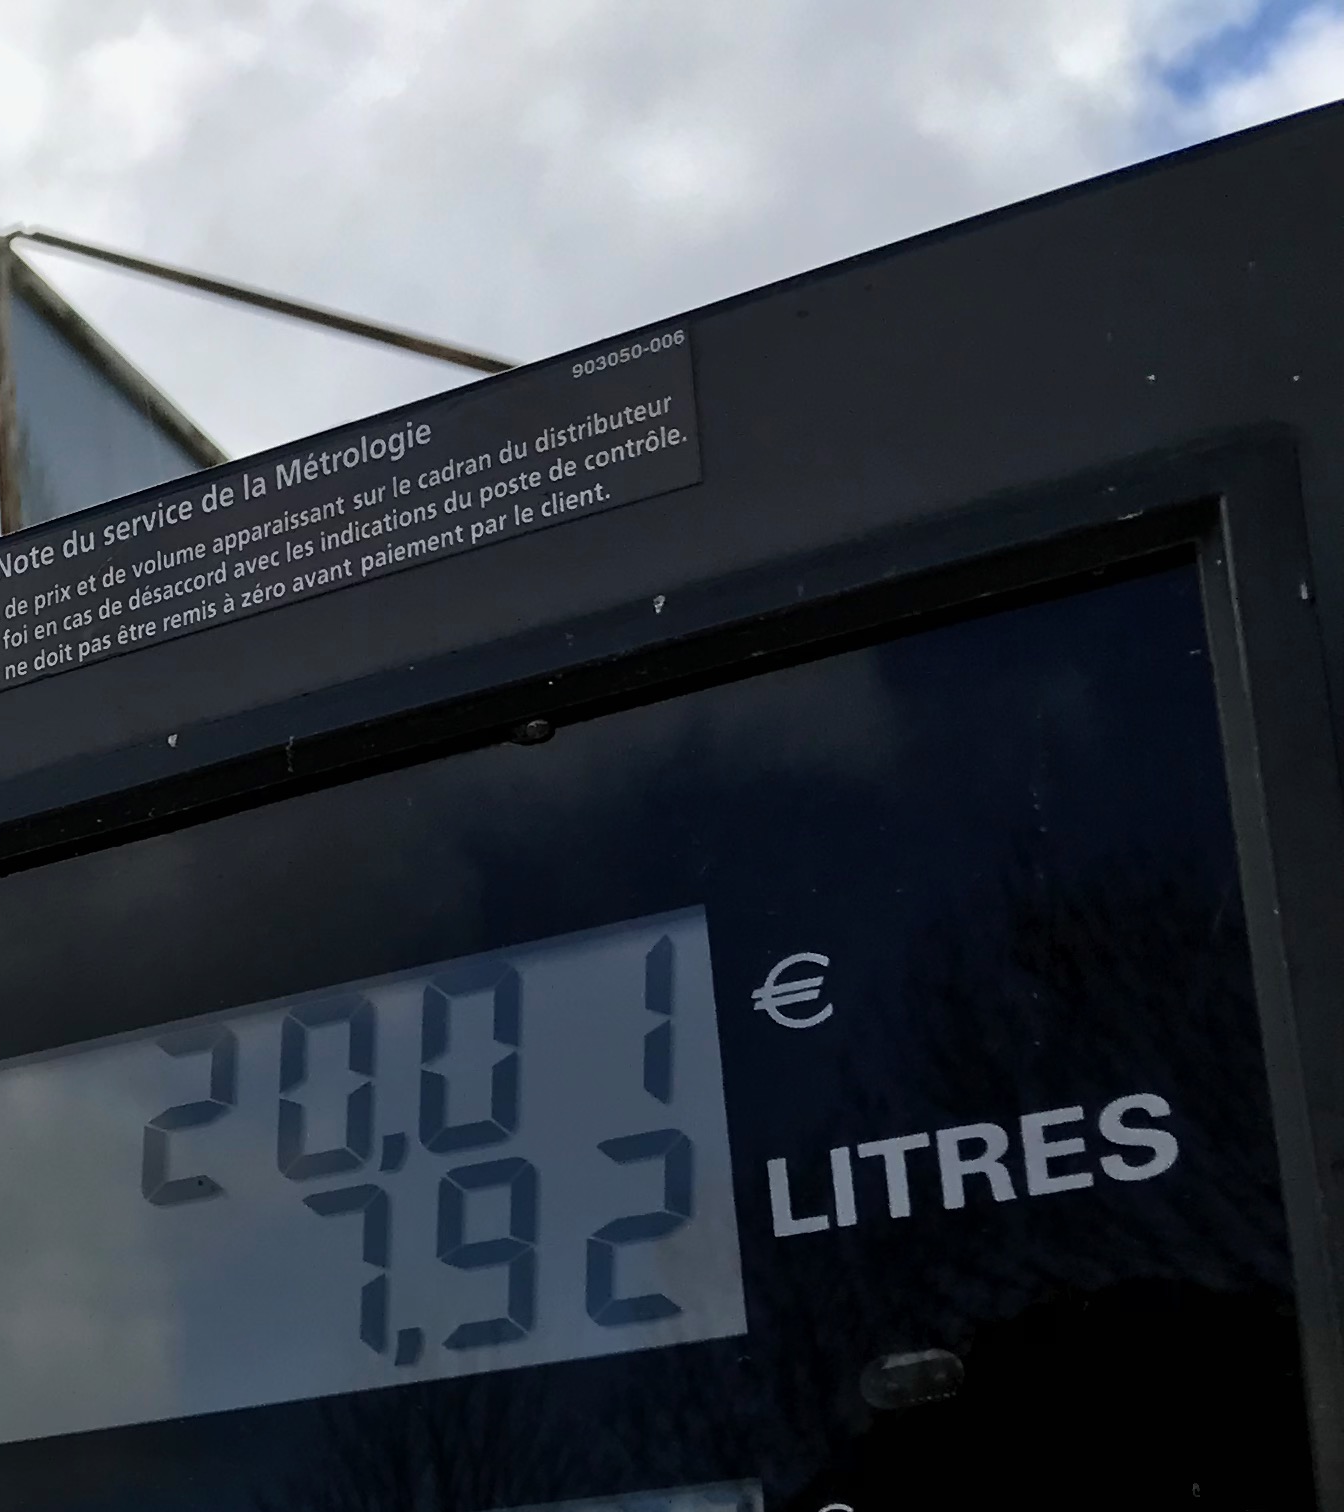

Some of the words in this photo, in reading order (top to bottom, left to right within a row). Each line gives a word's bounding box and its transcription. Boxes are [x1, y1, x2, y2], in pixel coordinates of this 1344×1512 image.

[572, 329, 685, 378] 903050-006
[3, 626, 28, 650] foi
[34, 619, 57, 640] en
[63, 609, 93, 632] cas
[99, 598, 122, 619] de
[128, 562, 226, 611] désaccord
[233, 550, 279, 579] avec
[286, 542, 313, 562] les
[321, 502, 437, 552] indications
[444, 490, 471, 514] du
[480, 470, 541, 509] poste
[549, 458, 576, 482] de
[584, 426, 687, 470] contrôle.
[5, 598, 27, 619] de
[34, 584, 71, 615] prix
[77, 574, 96, 597] et
[102, 566, 126, 588] de
[132, 542, 206, 577] volume
[213, 497, 345, 555] apparaissant
[354, 485, 385, 510] sur
[393, 476, 411, 498] le
[418, 453, 491, 489] cadran
[499, 440, 527, 464] du
[535, 396, 671, 453] distributeur
[63, 530, 95, 558] du
[104, 503, 193, 546] service
[201, 484, 234, 513] de
[244, 474, 266, 500] la
[276, 422, 431, 490] Métrologie
[5, 659, 27, 680] ne
[34, 644, 72, 670] doit
[78, 633, 111, 662] pas
[117, 620, 156, 644] être
[163, 600, 217, 632] remis
[222, 593, 235, 613] à
[241, 581, 285, 609] zéro
[292, 559, 352, 593] avant
[361, 525, 464, 577] paiement
[471, 513, 507, 544] par
[514, 504, 533, 525] le
[541, 482, 611, 518] client.
[751, 952, 833, 1029] €
[767, 1093, 1178, 1237] LITRES
